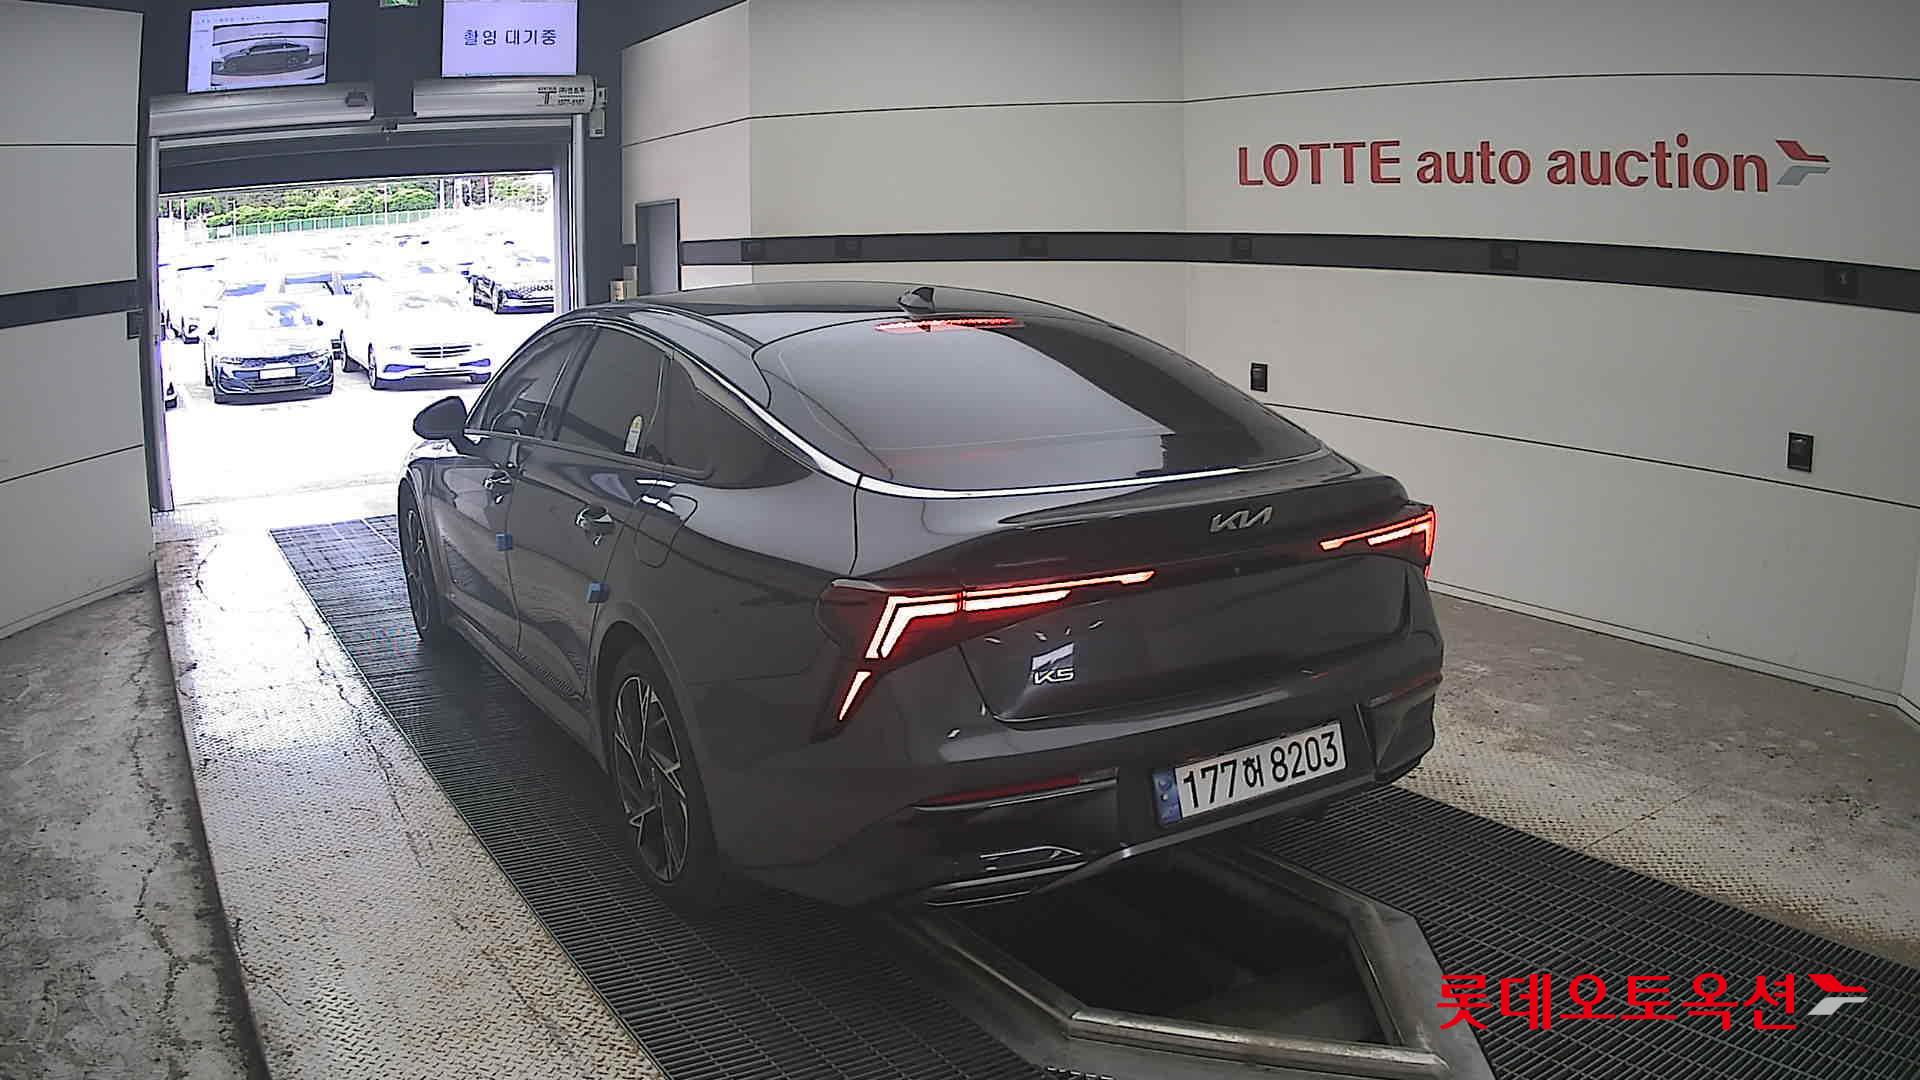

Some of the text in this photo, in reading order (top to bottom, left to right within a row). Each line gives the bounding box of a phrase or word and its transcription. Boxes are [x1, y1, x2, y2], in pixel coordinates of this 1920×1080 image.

[505, 29, 557, 46] 대기중
[1238, 133, 1769, 193] LOTTE auto auction
[1033, 668, 1075, 684] K5
[1183, 731, 1339, 809] 177허 8203
